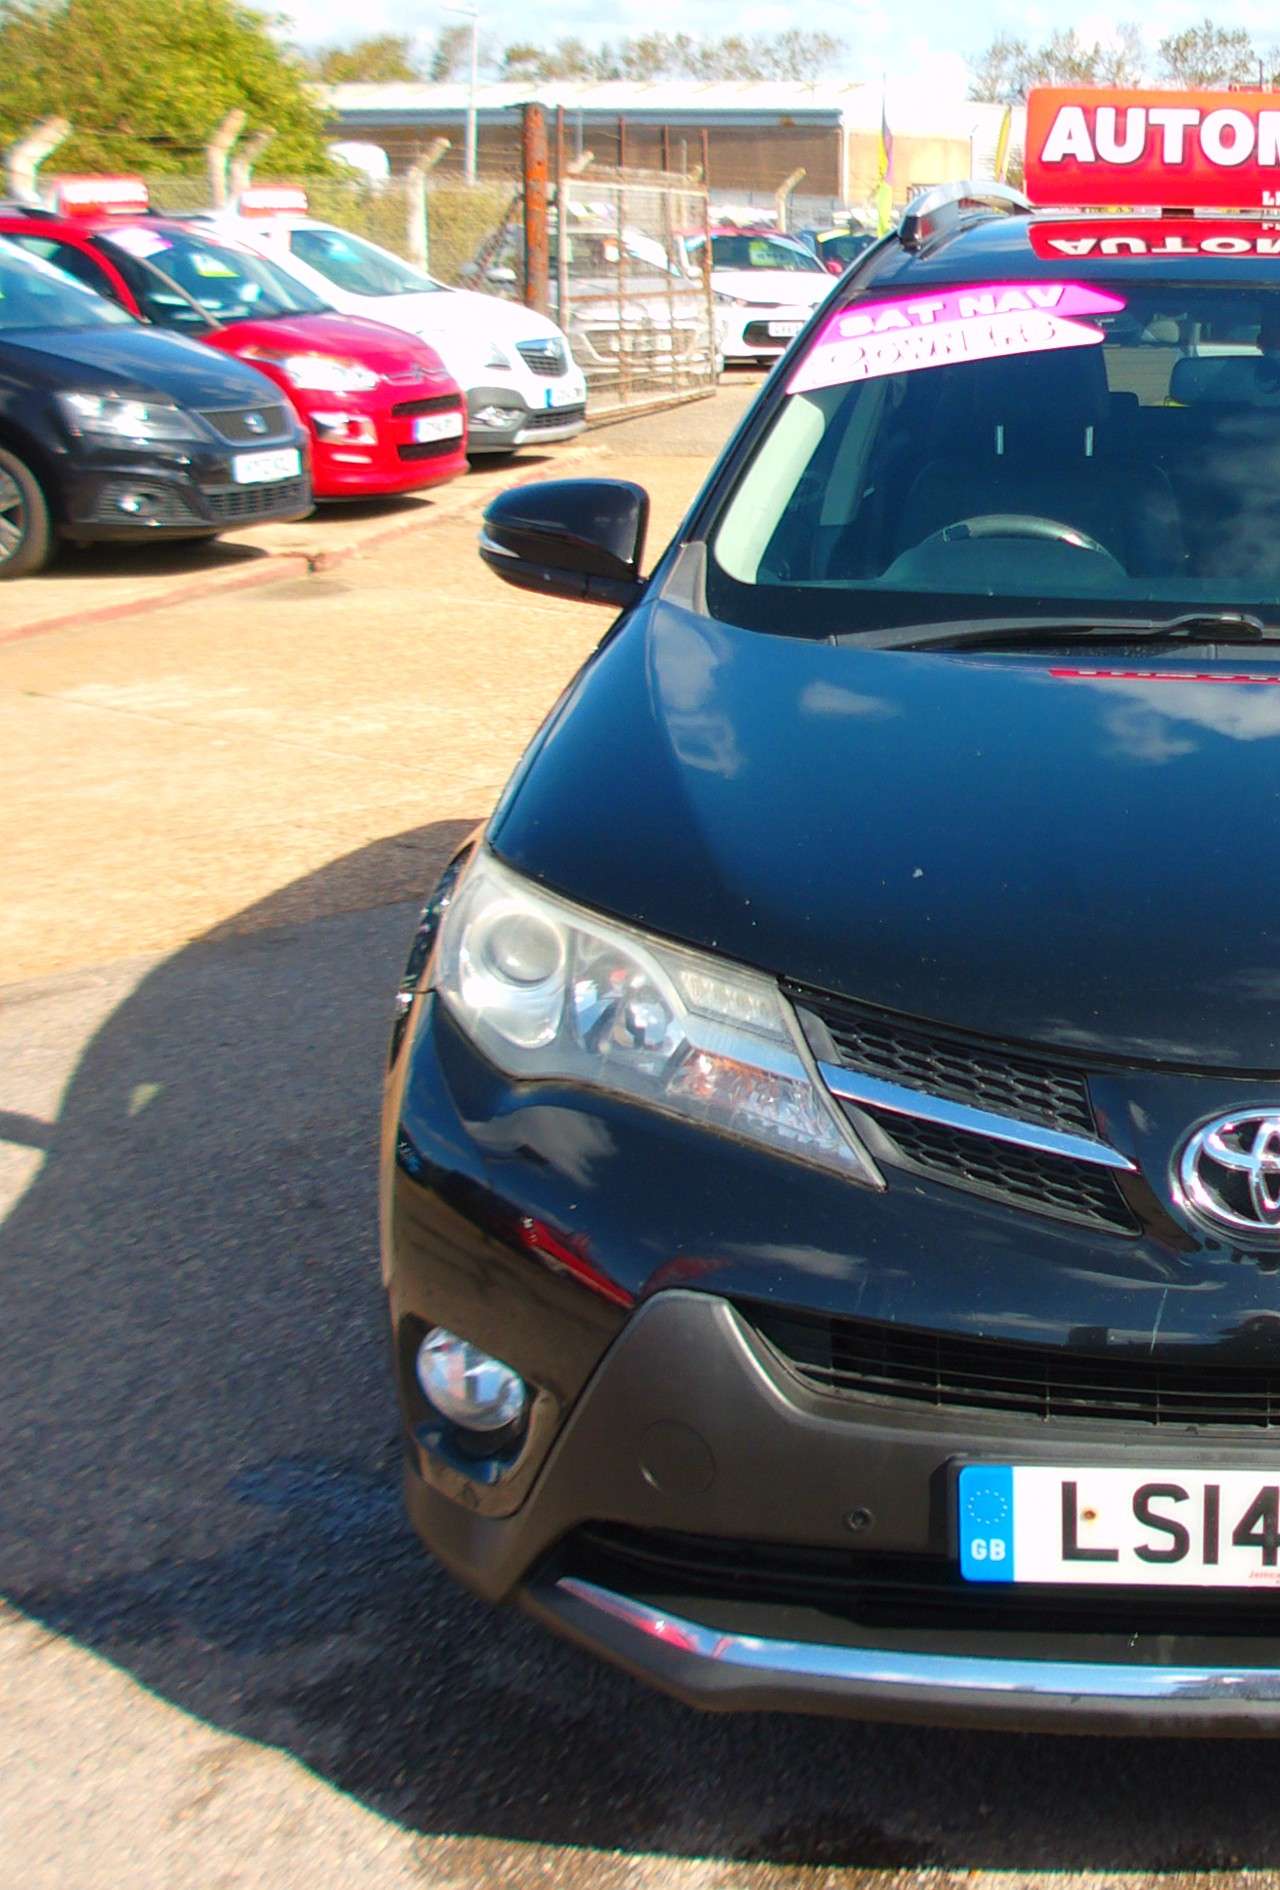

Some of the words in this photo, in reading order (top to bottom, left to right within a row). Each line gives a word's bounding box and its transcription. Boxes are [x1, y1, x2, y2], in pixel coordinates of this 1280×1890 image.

[838, 302, 944, 338] SAT
[958, 287, 1065, 319] NAV
[970, 1538, 1006, 1561] GB
